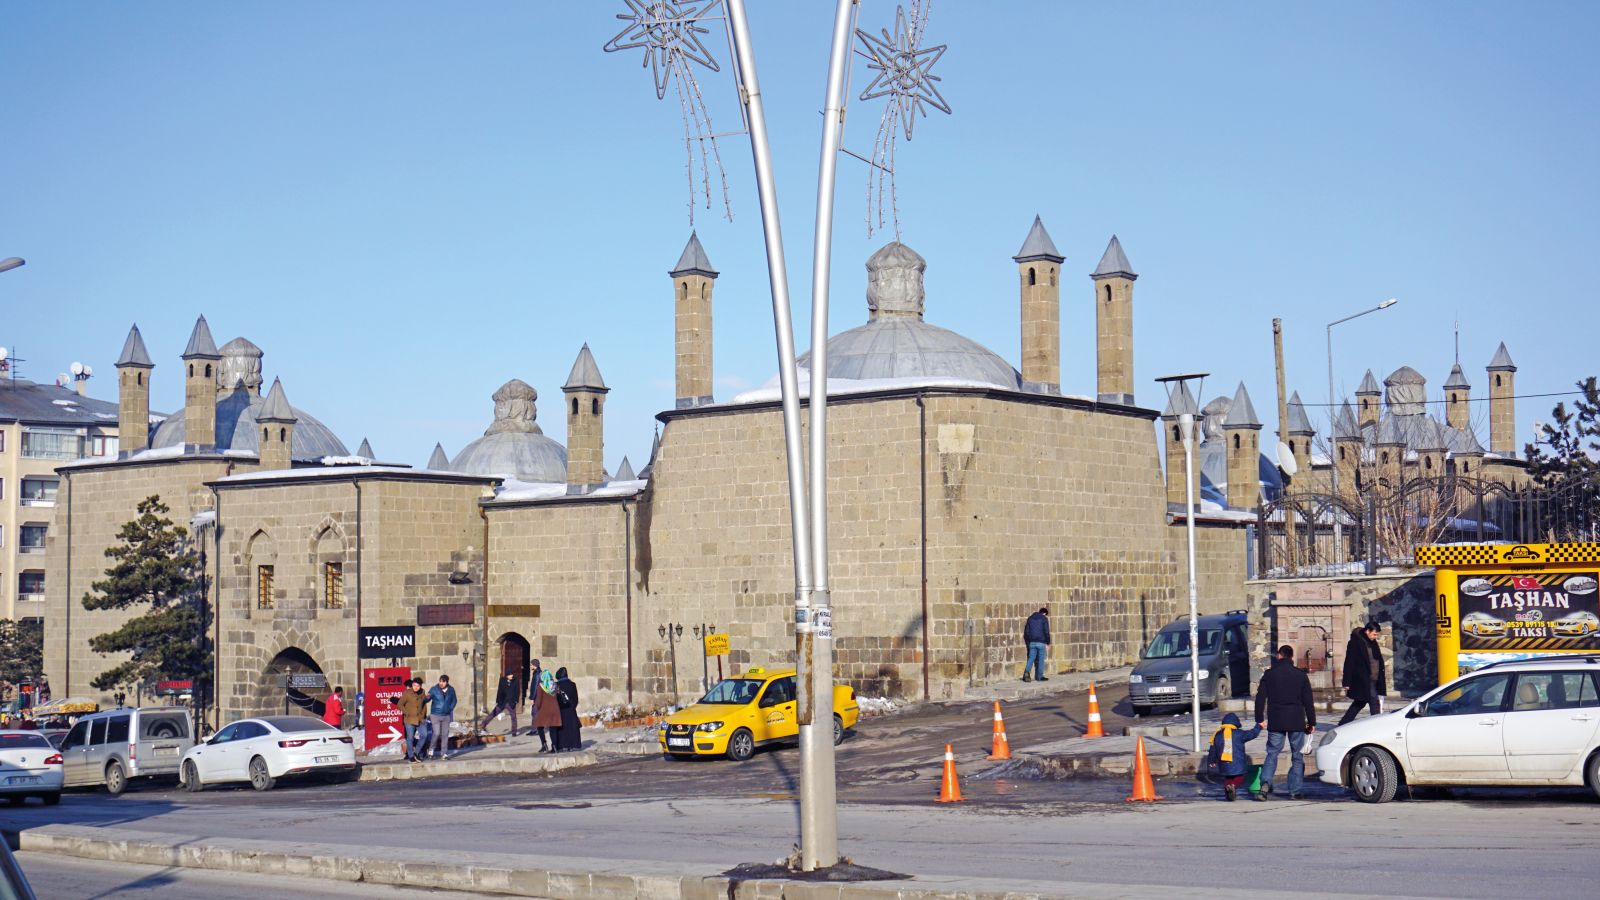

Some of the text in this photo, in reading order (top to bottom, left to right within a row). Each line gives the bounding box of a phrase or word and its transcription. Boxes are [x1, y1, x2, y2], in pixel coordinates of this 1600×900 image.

[1487, 591, 1570, 611] TAŞHAN
[1513, 627, 1547, 637] TAKSİ
[365, 635, 413, 650] TAŞHAN
